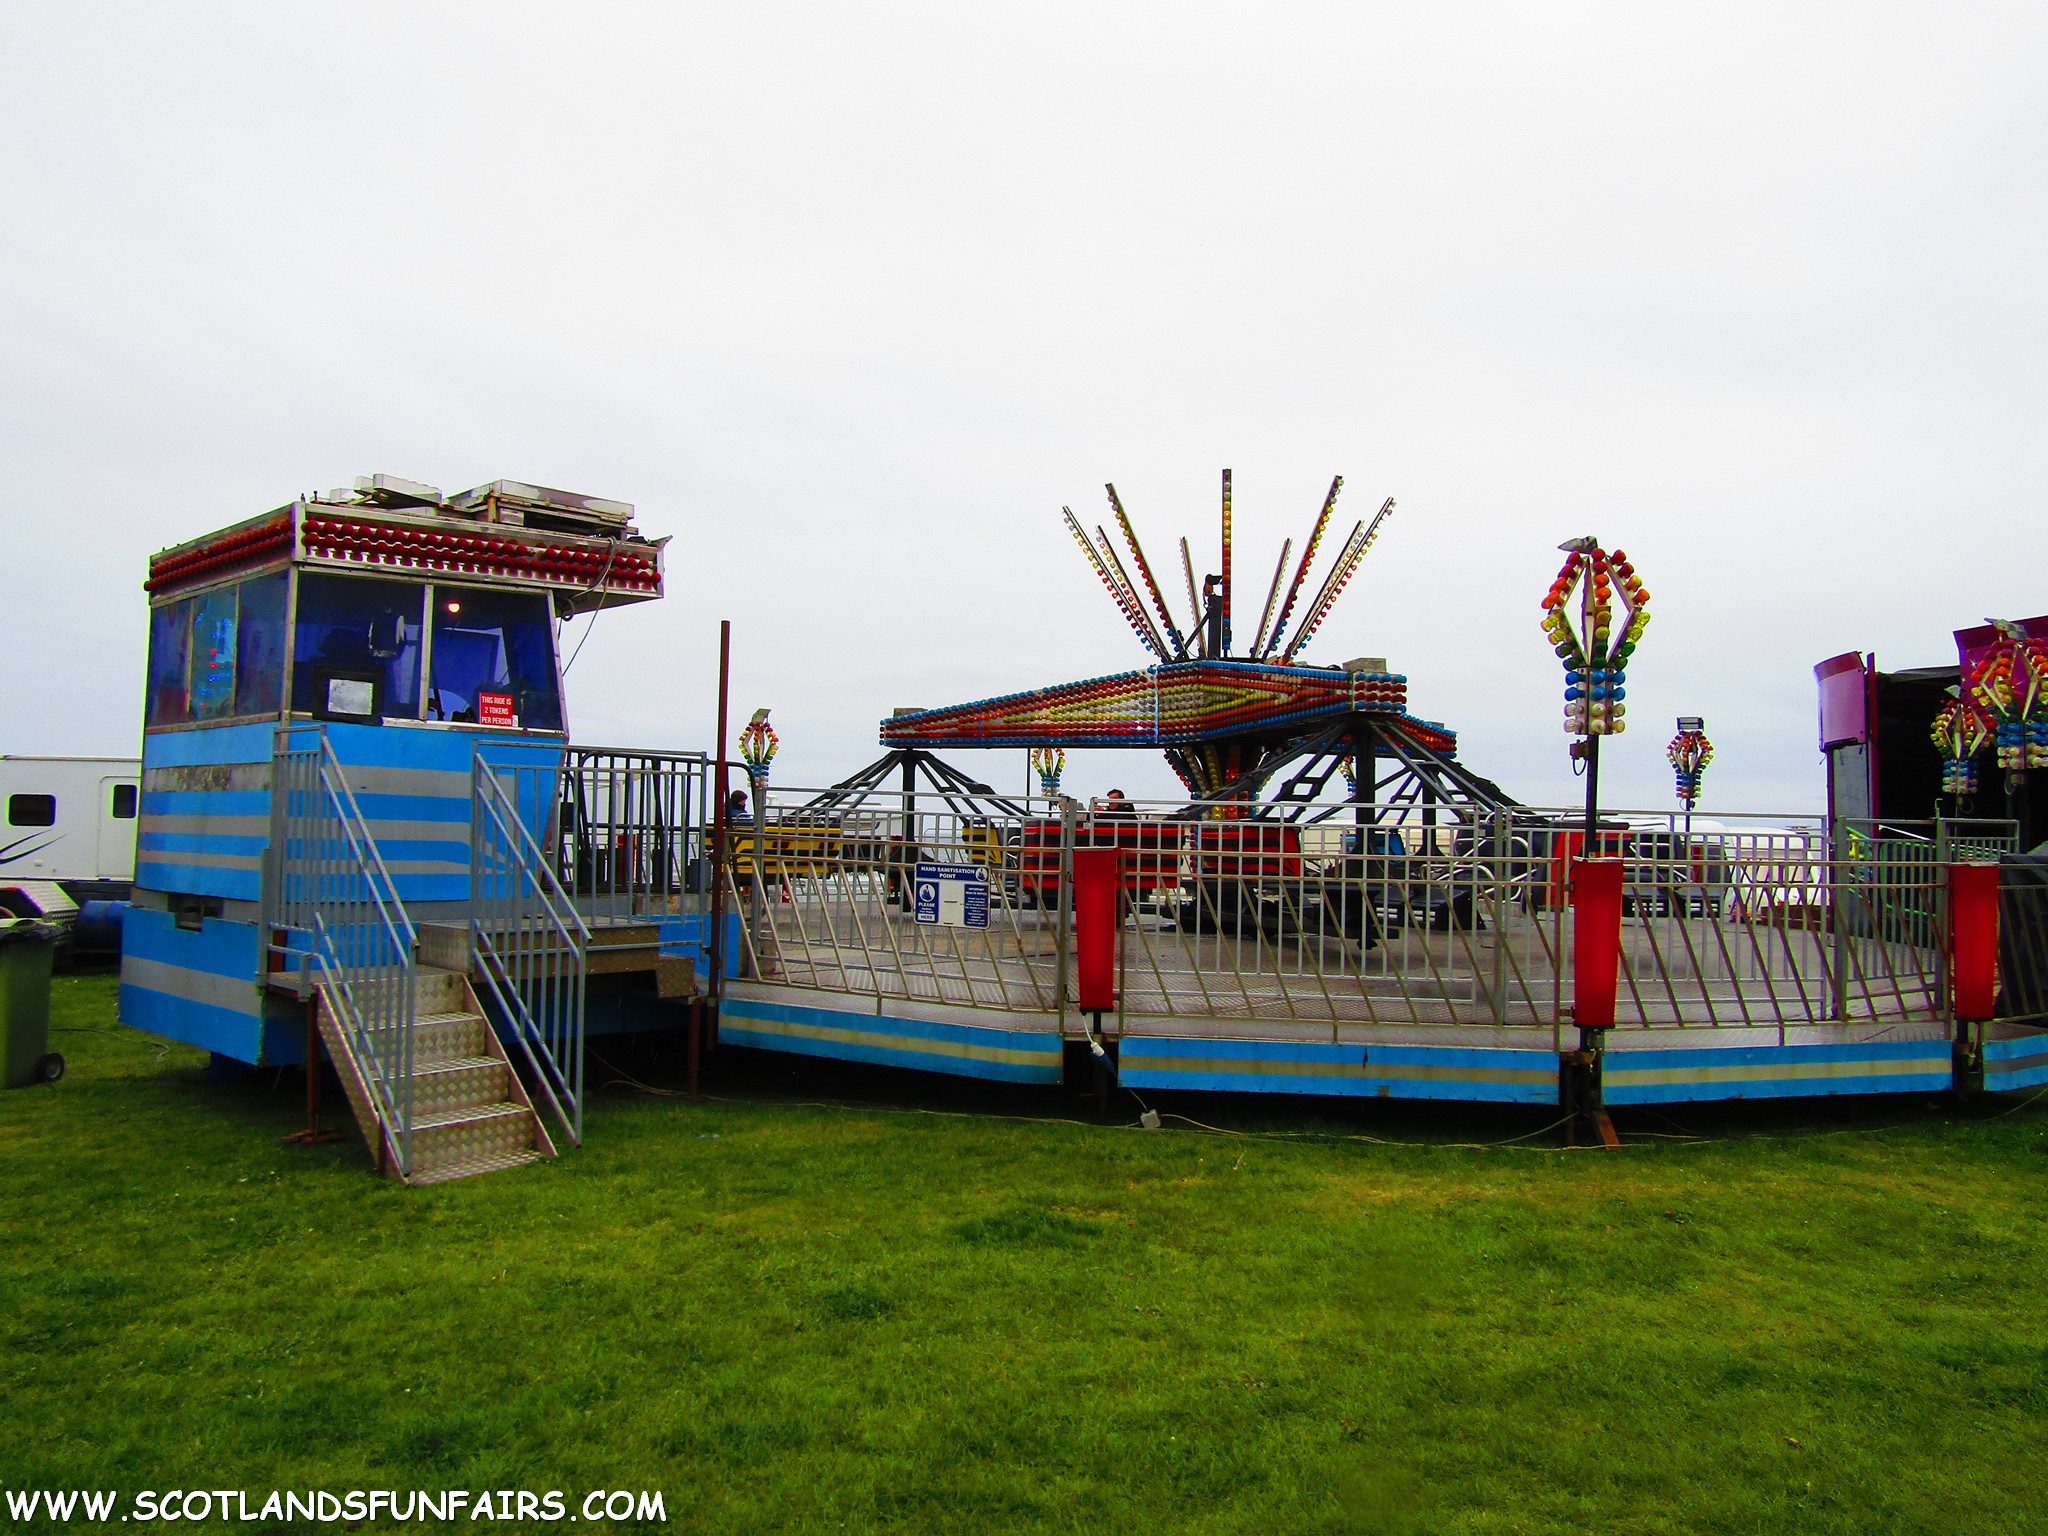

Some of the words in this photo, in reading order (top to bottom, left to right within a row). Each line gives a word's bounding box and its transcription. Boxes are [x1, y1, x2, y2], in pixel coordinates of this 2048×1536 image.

[481, 696, 493, 704] THIS
[484, 706, 488, 714] 2
[489, 706, 509, 715] TOKENS
[481, 716, 492, 724] PER
[492, 717, 512, 725] PERSON
